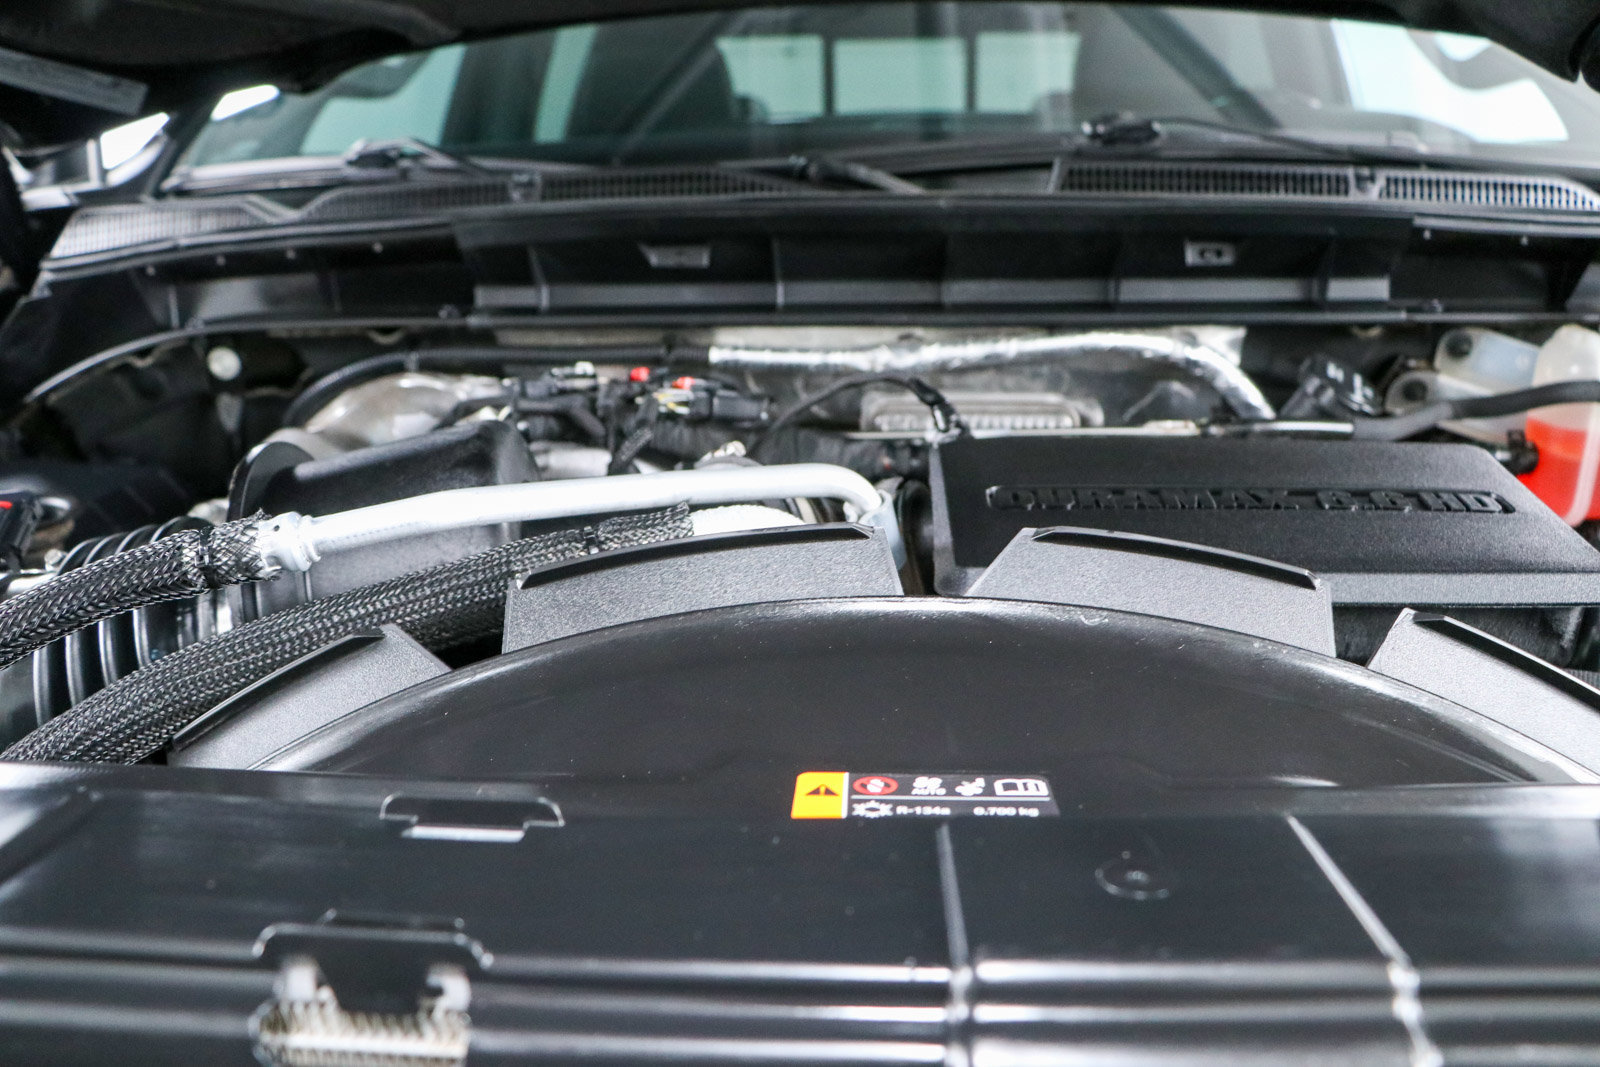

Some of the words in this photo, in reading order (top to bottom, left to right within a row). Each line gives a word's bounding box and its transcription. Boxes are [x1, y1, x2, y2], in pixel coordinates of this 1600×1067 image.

[1004, 488, 1299, 511] DURAMAX
[1418, 490, 1502, 514] HD
[911, 787, 947, 796] AUTO
[1018, 806, 1040, 818] kg
